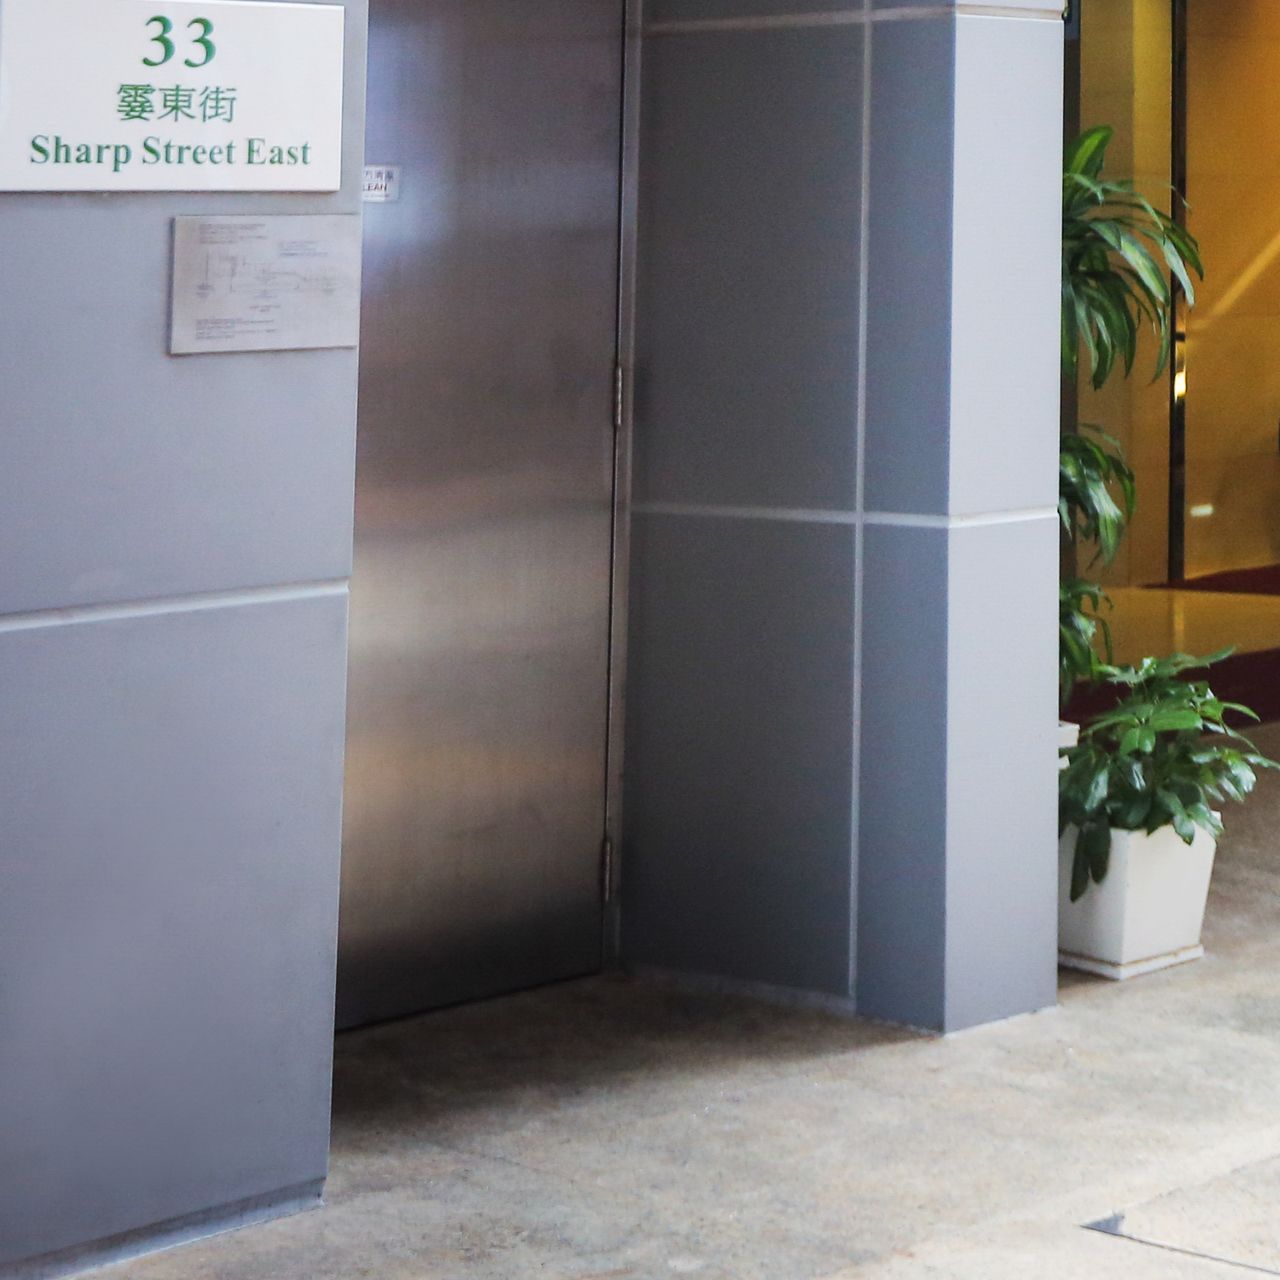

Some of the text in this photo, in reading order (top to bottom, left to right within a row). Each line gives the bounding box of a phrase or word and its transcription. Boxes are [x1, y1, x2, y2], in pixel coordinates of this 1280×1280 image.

[142, 15, 217, 68] 33
[30, 135, 312, 172] Sharp Street East
